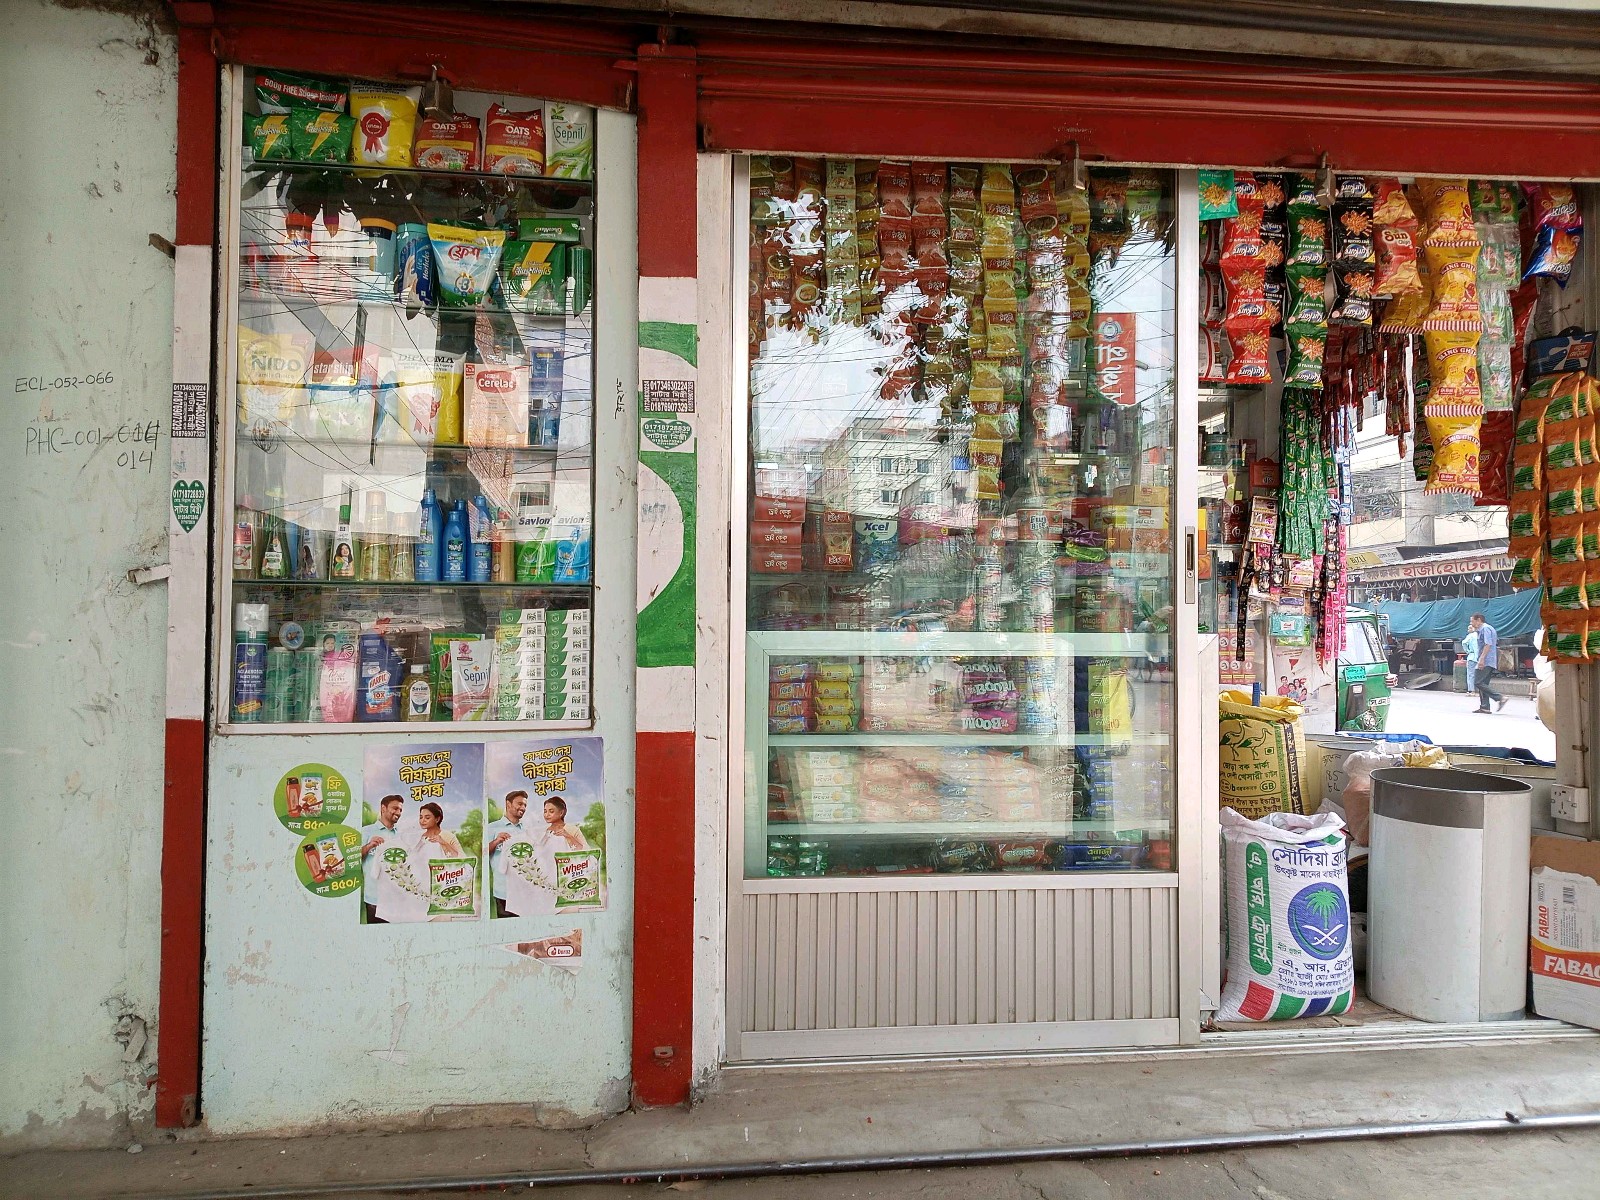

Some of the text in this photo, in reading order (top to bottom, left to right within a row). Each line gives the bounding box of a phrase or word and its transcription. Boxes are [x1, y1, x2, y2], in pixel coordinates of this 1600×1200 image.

[283, 84, 298, 96] FREE
[432, 123, 457, 131] OATS
[505, 125, 530, 136] OATS
[555, 126, 584, 141] Sepnil
[1384, 230, 1409, 242] Sun
[251, 354, 301, 372] NIDO
[15, 371, 114, 393] ECL-052-066
[478, 377, 514, 389] Cerelac
[117, 450, 153, 473] 014
[518, 516, 551, 526] Savlon
[558, 516, 585, 524] avlon
[864, 522, 890, 531] Xcel
[1437, 558, 1492, 575] হোটেল
[373, 690, 385, 699] 10X
[976, 680, 1016, 695] BOOM
[401, 750, 451, 765] কাপড়ে দেয়
[523, 745, 572, 762] কাপড়ে দেয়
[1254, 760, 1270, 769] মার্কা
[1238, 771, 1262, 780] খেসারী
[411, 782, 444, 801] সুগন্ধ
[535, 776, 566, 796] সুগন্ধ
[1272, 846, 1329, 866] সৌদিয়া
[436, 867, 464, 882] Wheel
[562, 860, 589, 875] Wheel
[1539, 905, 1550, 939] FABAO
[1303, 963, 1330, 973] আর,
